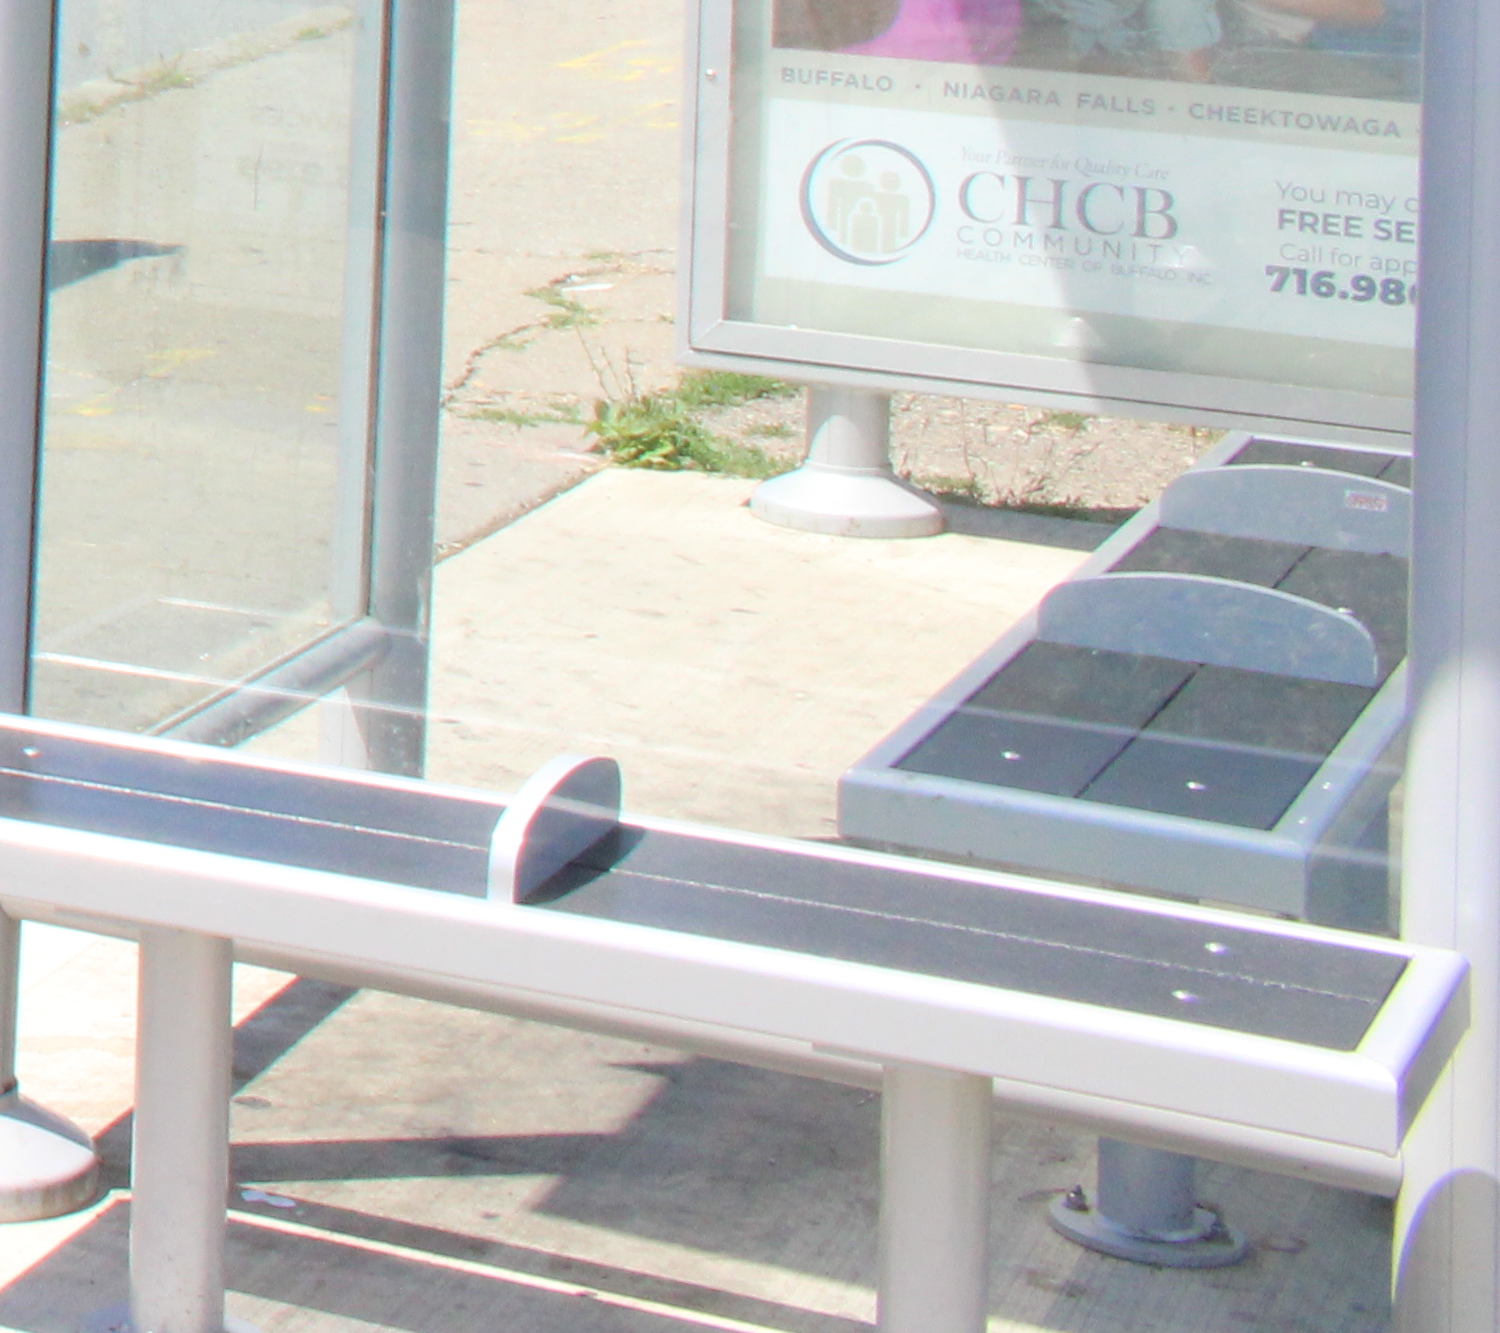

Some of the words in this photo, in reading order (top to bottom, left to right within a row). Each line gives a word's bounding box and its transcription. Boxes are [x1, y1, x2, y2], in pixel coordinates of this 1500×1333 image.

[781, 67, 893, 92] BUFFALO
[943, 81, 1061, 106] NIAGARA
[1076, 93, 1156, 115] FALLS
[1188, 103, 1401, 138] CHEEKTOWAGA
[1135, 162, 1169, 180] Care
[958, 170, 1178, 240] CHCB
[1275, 180, 1325, 203] You
[1335, 189, 1396, 214] may
[1277, 208, 1364, 238] FREE
[956, 225, 1192, 266] COMMUNITY
[957, 248, 1011, 263] HEALTH
[1018, 254, 1074, 271] CENTER
[1279, 242, 1322, 263] Call
[1331, 247, 1362, 268] for
[1264, 264, 1419, 306] 716.98
